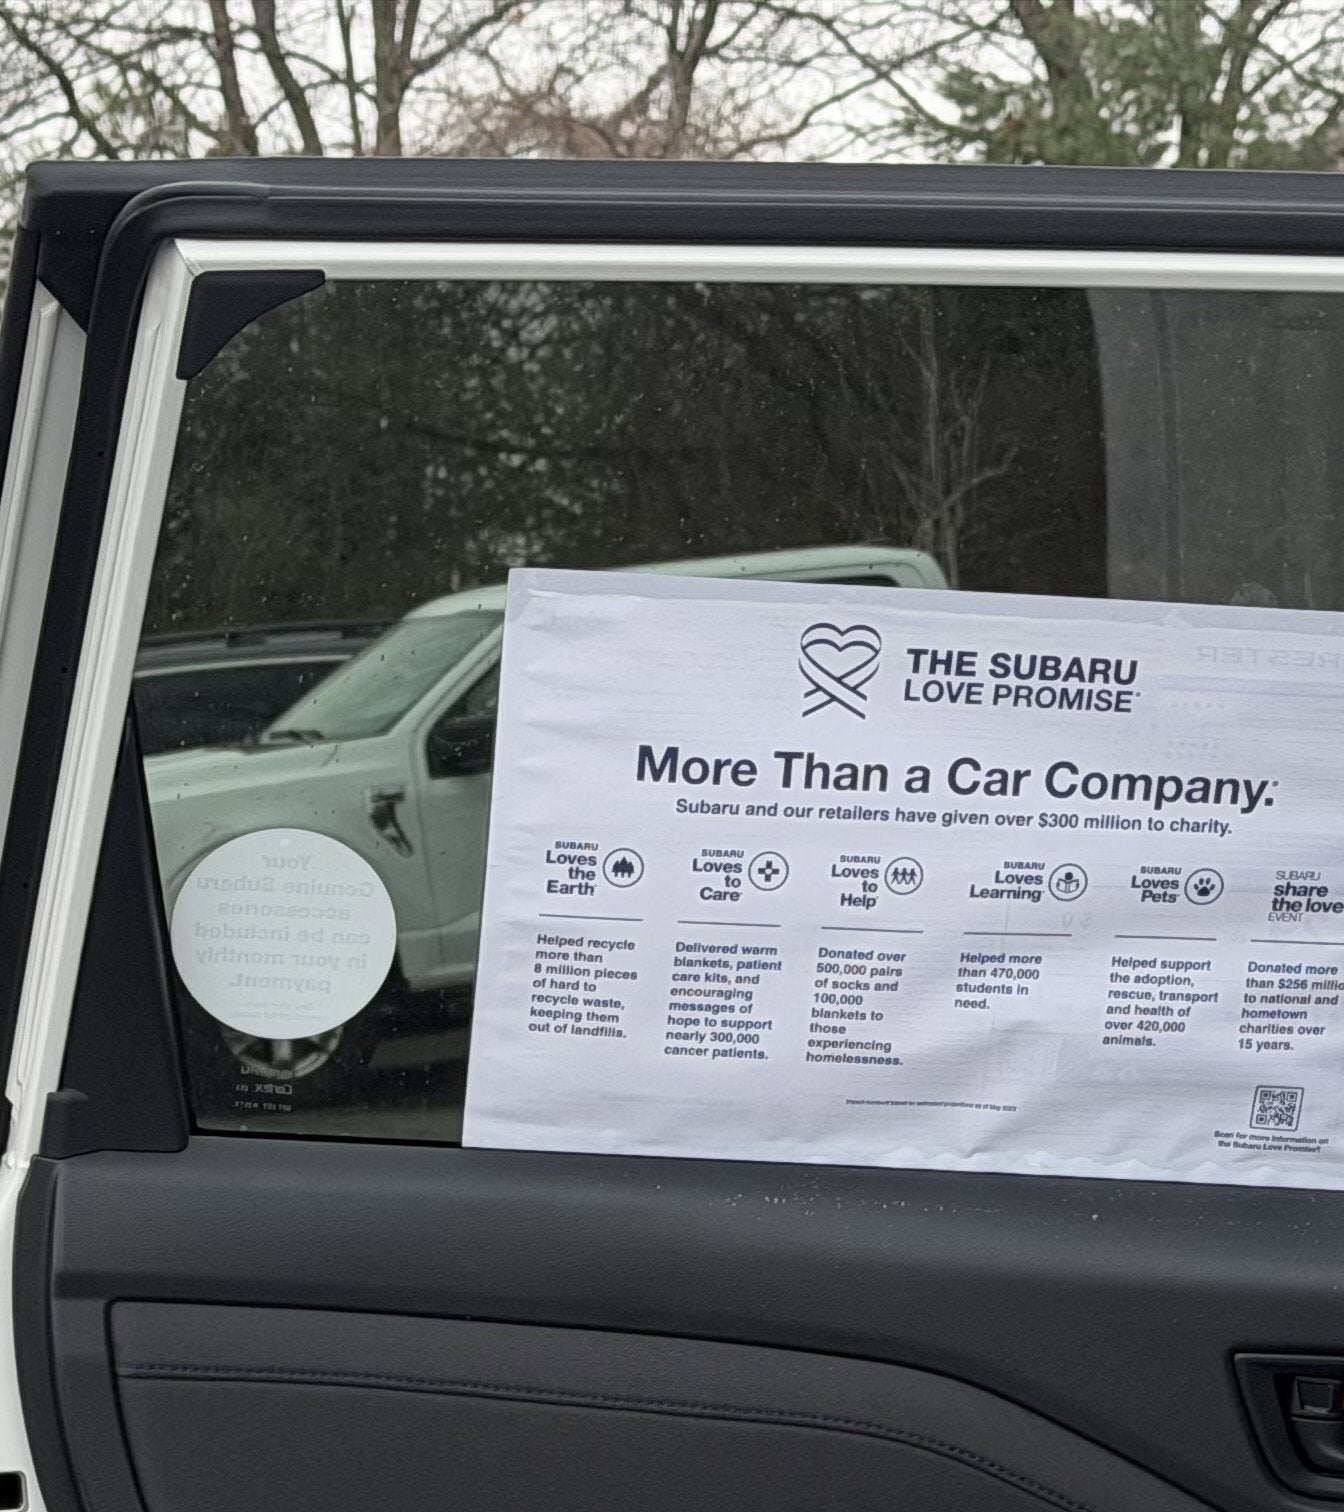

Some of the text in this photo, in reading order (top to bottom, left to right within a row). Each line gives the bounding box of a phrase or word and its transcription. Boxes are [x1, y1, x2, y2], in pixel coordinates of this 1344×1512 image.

[906, 648, 1138, 685] THE SUBARU
[904, 679, 984, 705] LOVE
[636, 744, 758, 787] More
[773, 750, 889, 793] Than
[904, 764, 931, 794] a
[947, 757, 1032, 797] Car
[676, 798, 1233, 837] Subaru and our retailers have given over $300 million to charity.
[555, 840, 599, 851] SUBARU
[546, 850, 597, 866] Loves
[701, 849, 744, 858] SUBARU
[840, 855, 881, 864] SUBARU
[692, 858, 743, 874] Loves
[831, 864, 879, 879] Loves
[1004, 861, 1045, 870] SUBARU
[1140, 866, 1182, 875] SUBARU
[568, 866, 596, 880] the
[994, 870, 1044, 885] Loves
[1275, 870, 1322, 881] SUBARU
[724, 875, 742, 888] to
[862, 880, 878, 893] to
[1131, 875, 1179, 890] Loves
[1273, 882, 1329, 897] share
[1271, 897, 1302, 912] the
[1267, 912, 1304, 922] EVENT
[536, 933, 636, 951] Helped recycle
[675, 941, 778, 956] Delivered warm
[535, 950, 603, 963] more than
[818, 947, 907, 962] Donated over
[960, 952, 1043, 965] Helped more
[673, 956, 782, 972] blankets, patient
[816, 962, 903, 979] 500,000 pairs
[1111, 956, 1212, 972] Helped support
[1248, 961, 1338, 975] Donated more
[534, 963, 637, 980] 8 million pieces
[672, 972, 760, 985] care kits, and
[958, 967, 1040, 981] than 470,000
[532, 978, 597, 992] of hard to
[814, 978, 899, 991] of socks and
[1109, 972, 1195, 988] the adoption,
[1246, 977, 1274, 988] than
[1277, 978, 1308, 990] $256
[670, 987, 753, 1001] encouraging
[955, 982, 1029, 995] students in
[531, 993, 625, 1011] recycle waste,
[813, 992, 863, 1006] 100,000
[954, 998, 991, 1009] need.
[1108, 989, 1219, 1004] rescue, transport
[1243, 993, 1339, 1006] to national and
[529, 1006, 619, 1023] keeping them
[668, 1002, 753, 1015] messages of
[811, 1007, 884, 1021] blankets to
[1106, 1004, 1192, 1017] and health of
[1241, 1007, 1308, 1019] hometown
[528, 1022, 627, 1038] out of landfills.
[667, 1015, 772, 1031] hope to support
[809, 1022, 847, 1034] those
[1104, 1020, 1186, 1034] over 420,000
[1239, 1022, 1327, 1035] charities over
[665, 1030, 760, 1045] nearly 300,000
[1102, 1034, 1156, 1046] animals.
[807, 1038, 892, 1053] experiencing
[1238, 1038, 1294, 1053] 15 years.
[664, 1046, 768, 1060] cancer patients.
[805, 1051, 904, 1066] homelessness.
[1214, 1130, 1234, 1138] Scan
